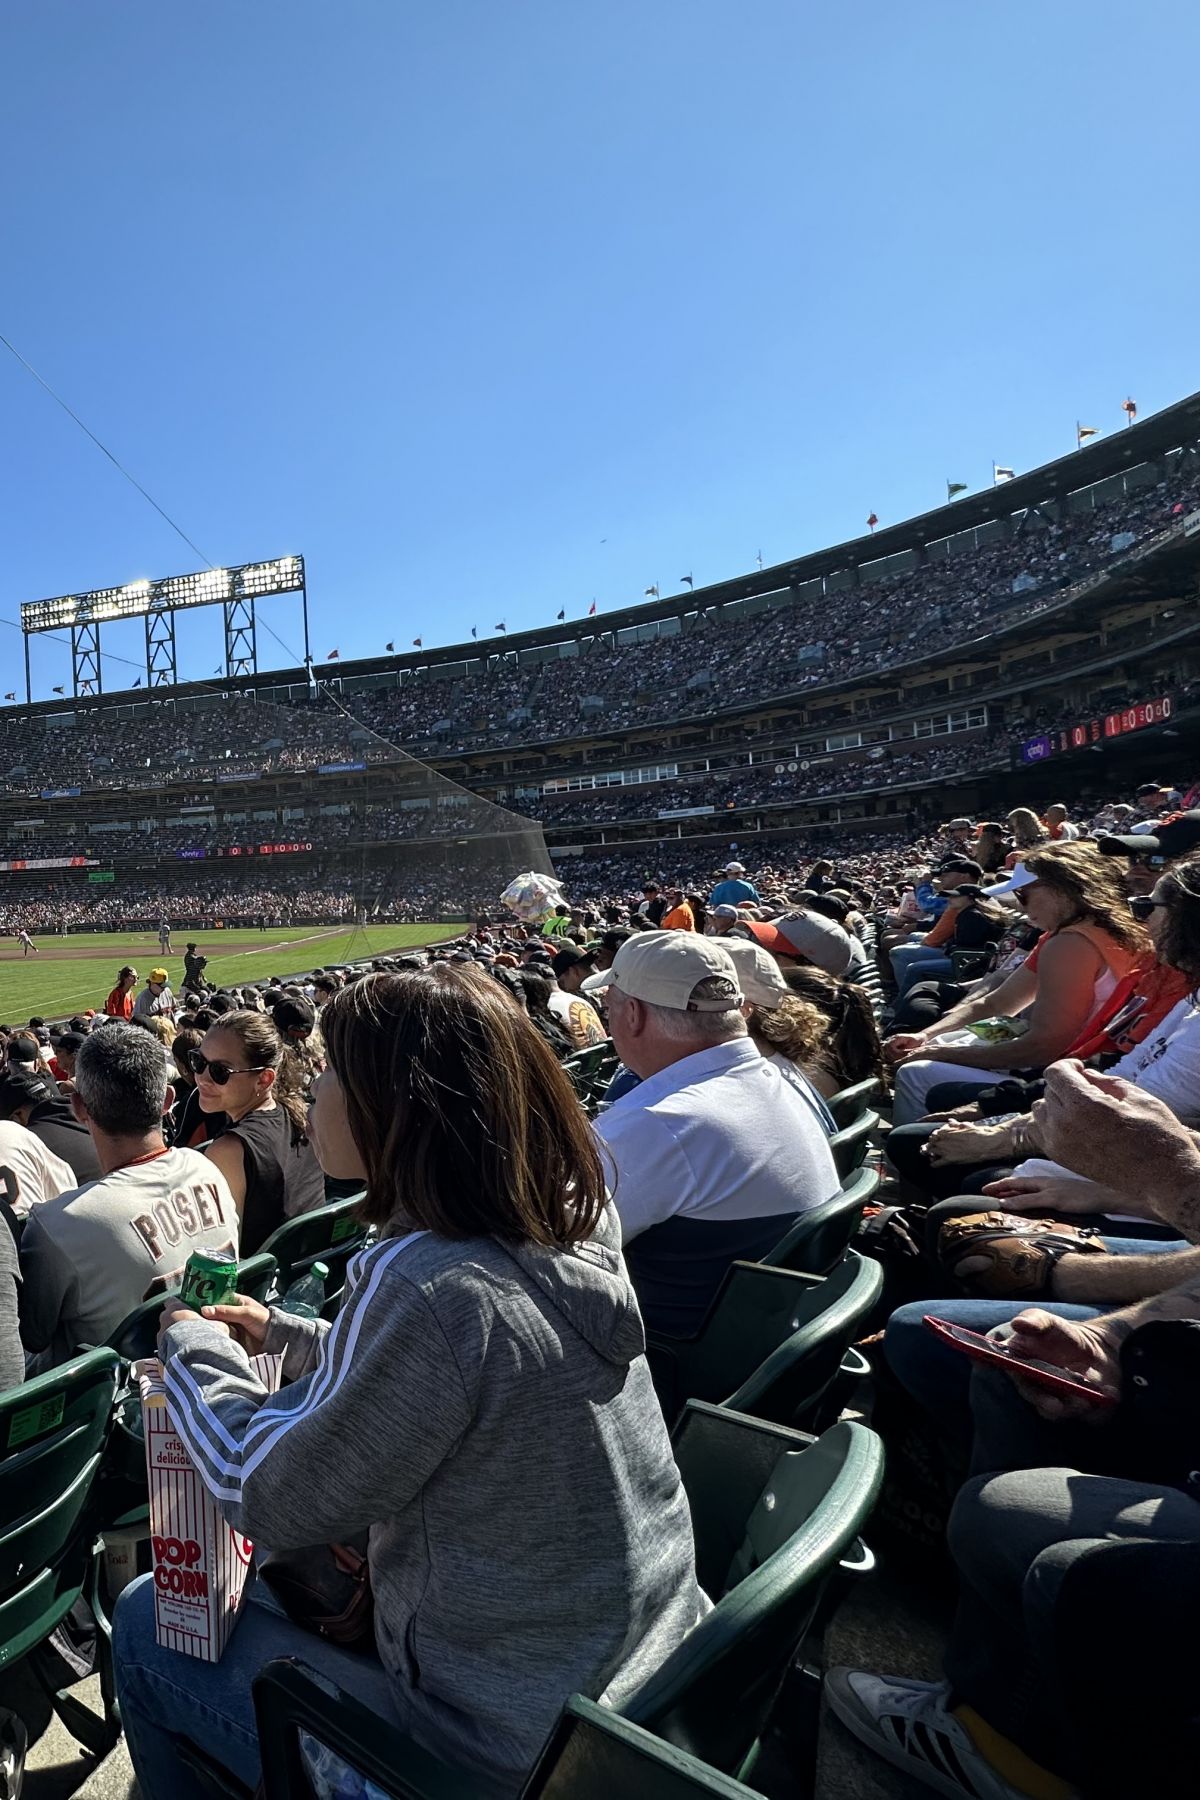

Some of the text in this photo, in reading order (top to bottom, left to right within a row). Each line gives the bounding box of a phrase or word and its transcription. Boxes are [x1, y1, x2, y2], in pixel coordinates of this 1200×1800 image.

[1109, 717, 1115, 735] 1
[1129, 710, 1135, 728] 0
[1145, 704, 1153, 722] 0
[1162, 698, 1170, 717] 0
[1075, 728, 1082, 744] 0
[279, 844, 286, 852] 0
[305, 843, 312, 851] 0
[130, 1183, 226, 1264] POSEY
[152, 1535, 201, 1568] POP
[154, 1565, 208, 1598] CORN
